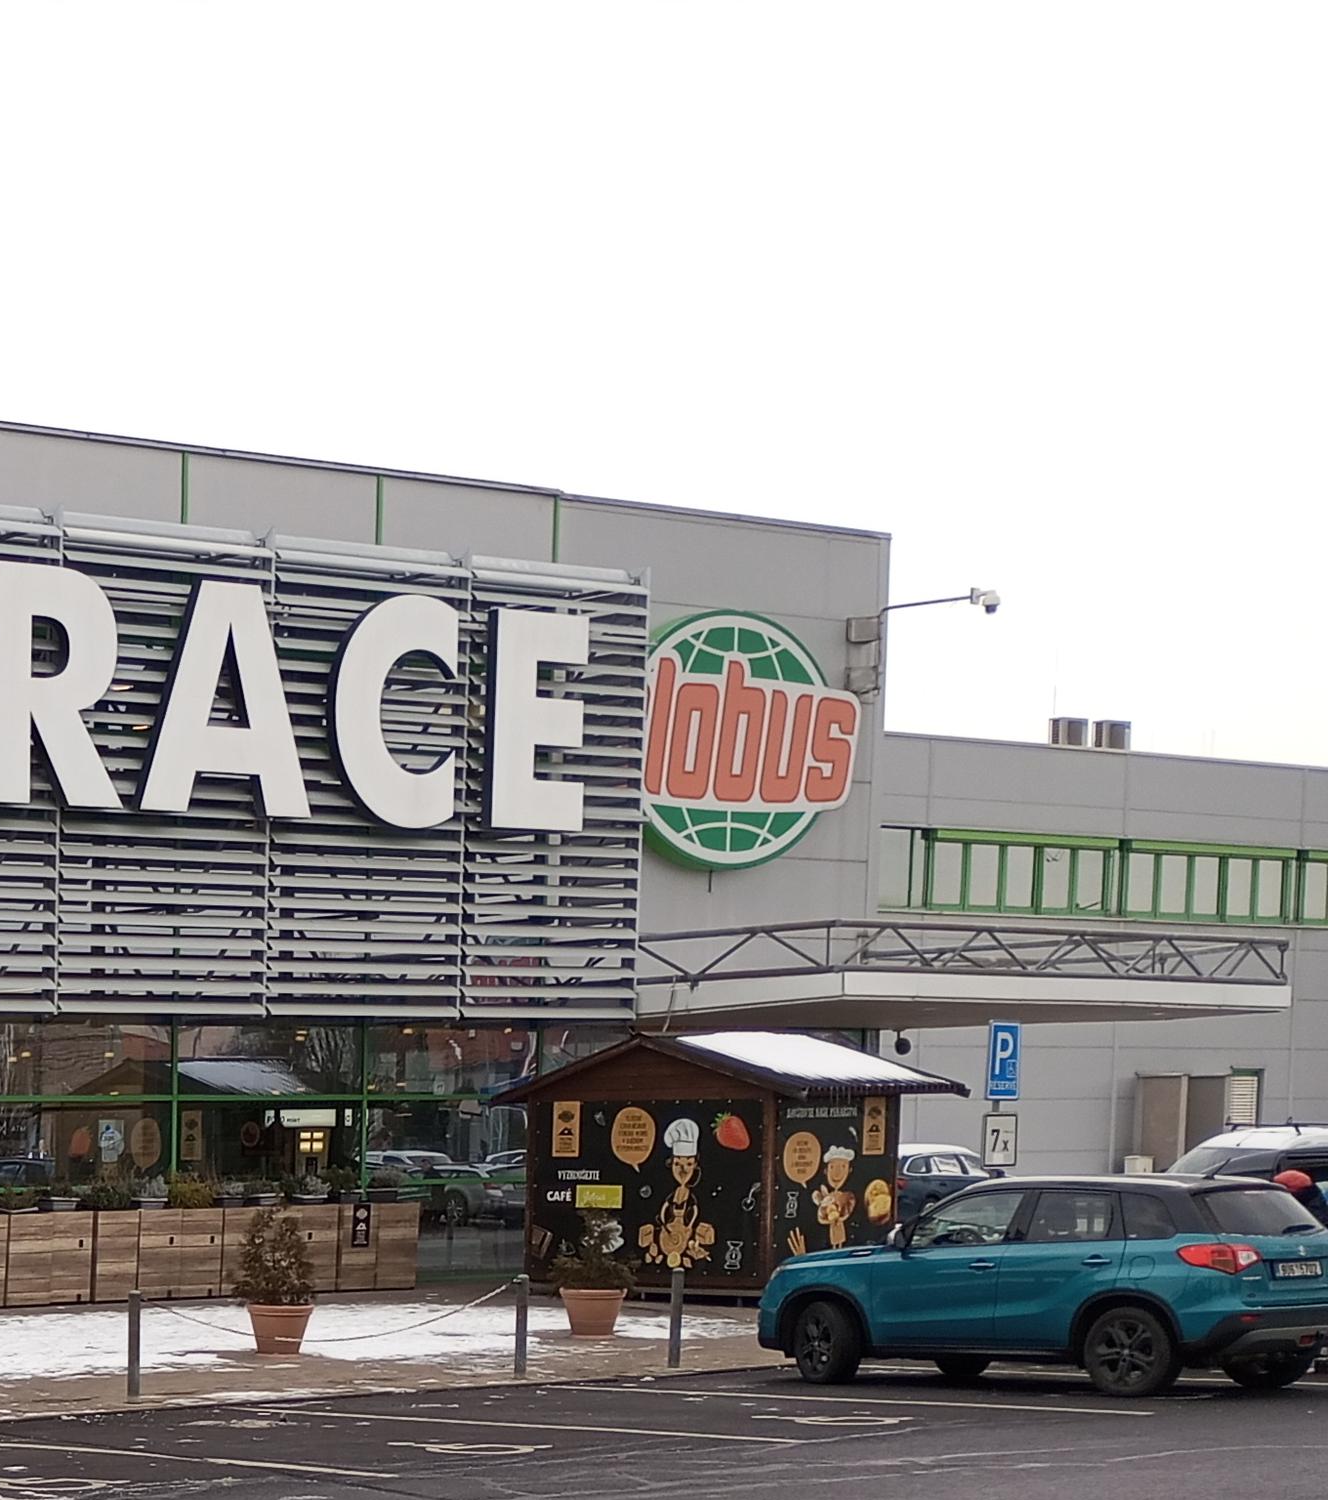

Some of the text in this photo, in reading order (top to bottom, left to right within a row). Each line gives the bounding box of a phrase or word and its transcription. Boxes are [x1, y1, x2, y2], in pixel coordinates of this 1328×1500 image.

[644, 657, 858, 804] lobus
[994, 1031, 1014, 1075] P
[546, 1187, 573, 1202] CAFÉ
